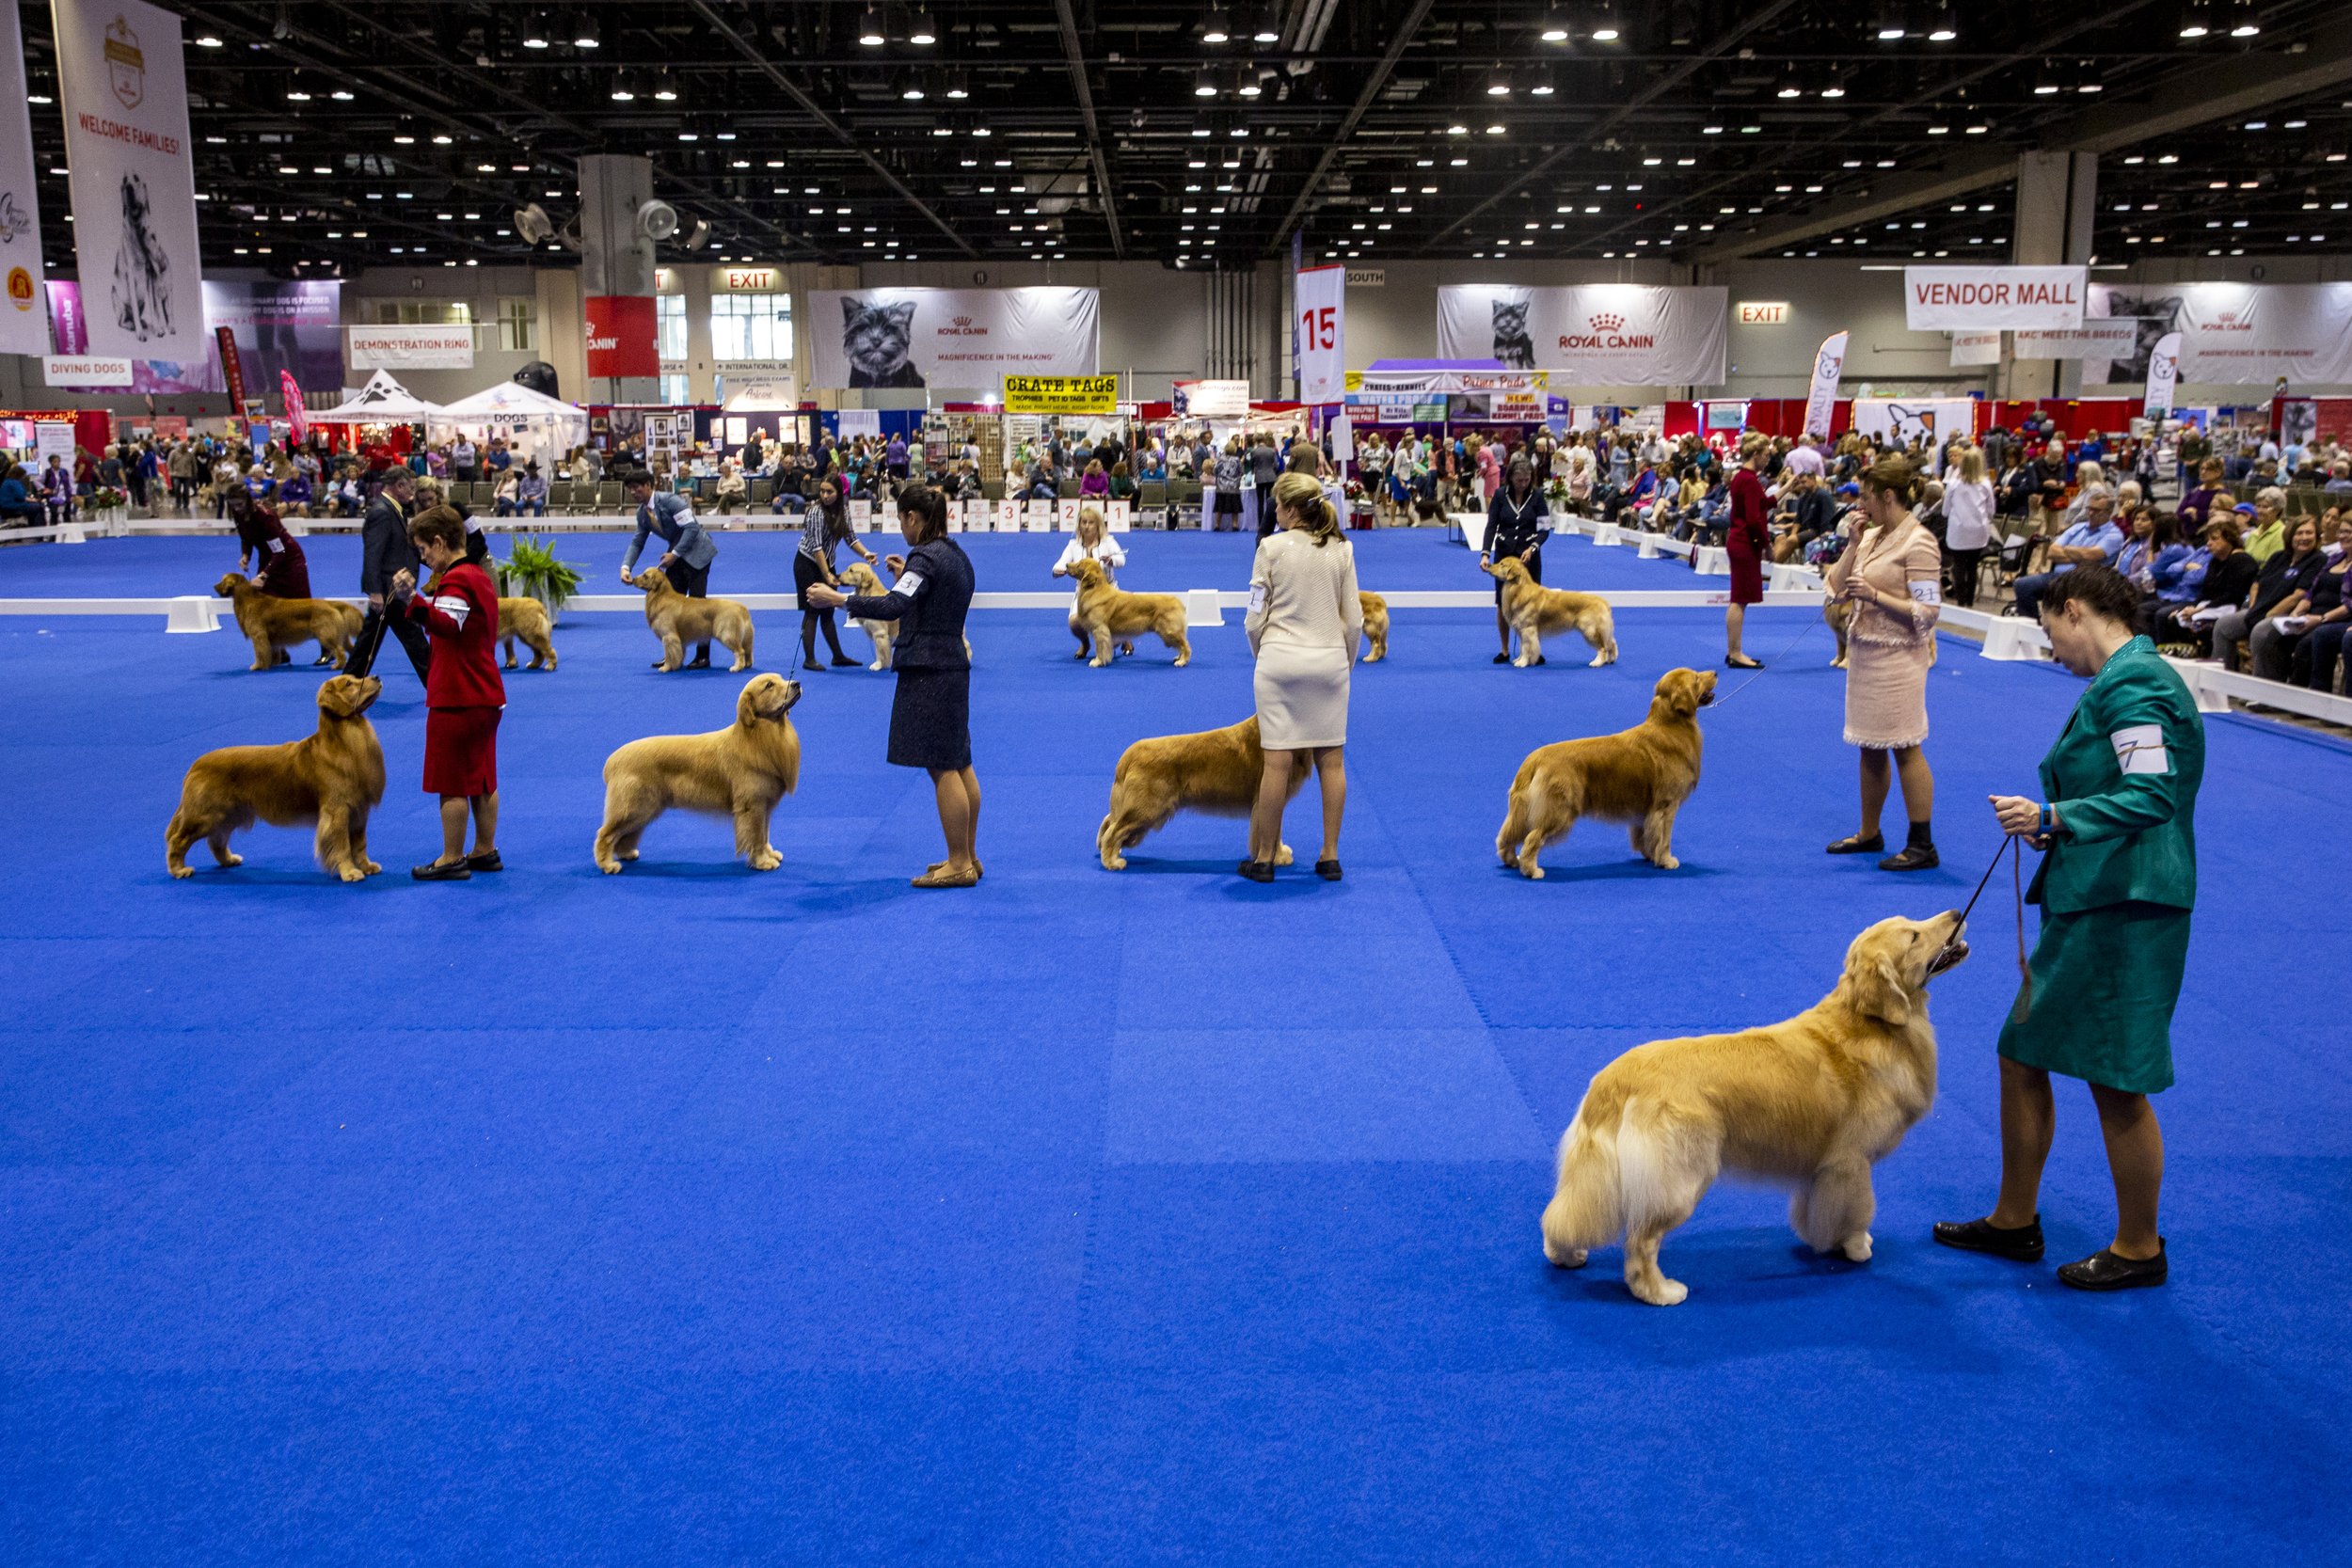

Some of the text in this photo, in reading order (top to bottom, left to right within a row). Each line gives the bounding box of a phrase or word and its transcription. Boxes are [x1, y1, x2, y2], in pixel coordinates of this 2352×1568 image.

[79, 112, 180, 156] WELCOME FAMILIES!
[730, 273, 770, 289] EXIT
[1347, 273, 1384, 282] SOUTH
[1916, 284, 2076, 305] VENDOR MALL
[1743, 307, 1783, 322] EXIT
[938, 327, 988, 336] ROYAL CANIN
[1303, 307, 1336, 351] 15
[2042, 330, 2070, 340] MEET
[2072, 330, 2090, 340] THE
[2091, 330, 2132, 340] BREEDS
[354, 340, 469, 350] DEMONSTRATION RING
[1559, 336, 1654, 349] ROYAL CANIN
[51, 363, 125, 374] DIVING DOGS
[1007, 378, 1115, 392] CRATE TAGS
[1396, 383, 1426, 391] KENNELS
[1499, 374, 1526, 388] Pads
[494, 414, 528, 423] DOGS
[1491, 412, 1521, 420] KENNEL
[947, 507, 956, 520] 4
[1005, 506, 1013, 519] 3
[1065, 505, 1074, 519] 2
[1114, 507, 1121, 520] 1
[1914, 588, 1935, 602] 21
[2119, 739, 2138, 768] 7
